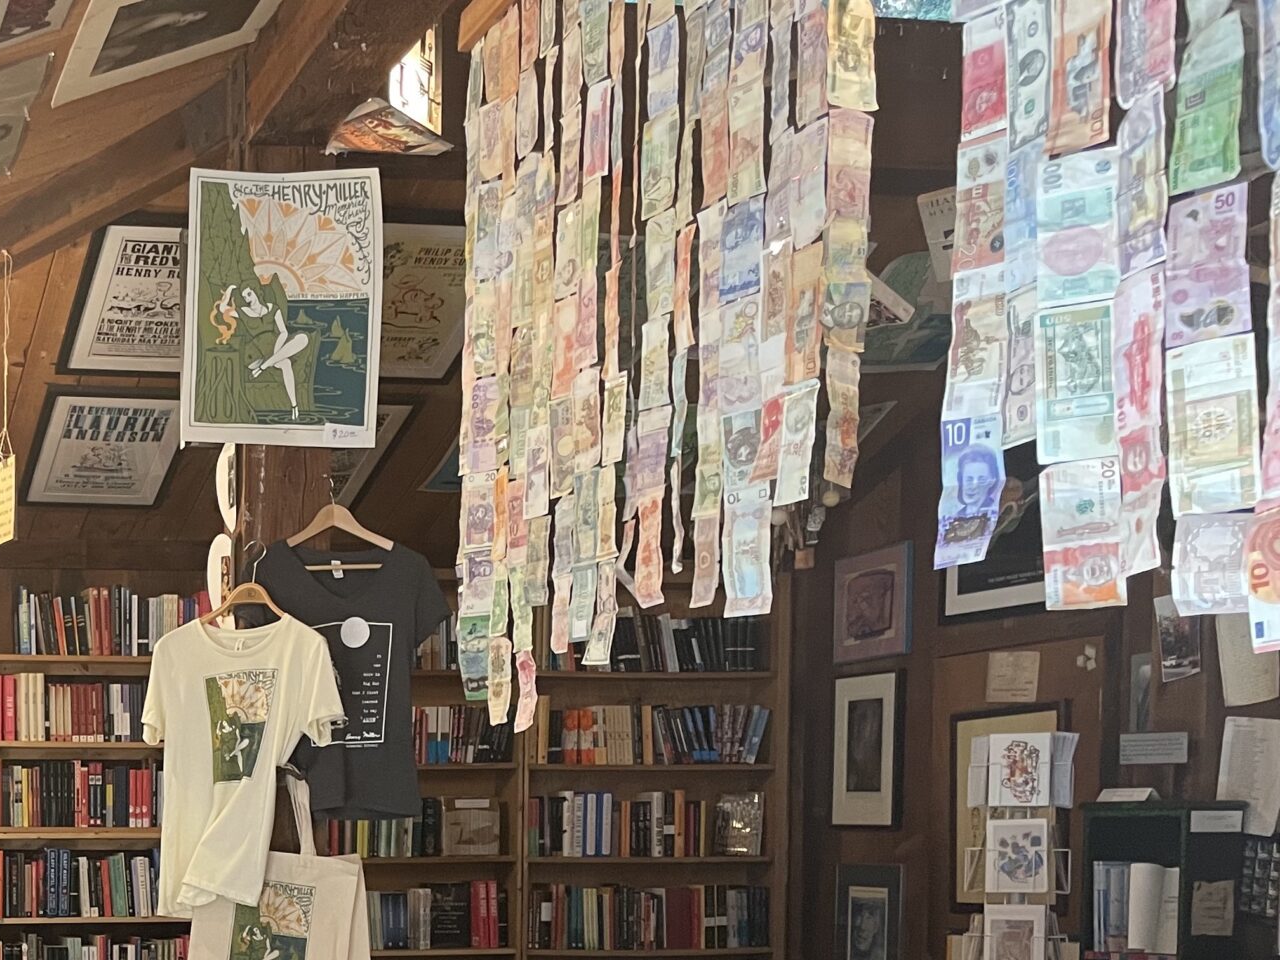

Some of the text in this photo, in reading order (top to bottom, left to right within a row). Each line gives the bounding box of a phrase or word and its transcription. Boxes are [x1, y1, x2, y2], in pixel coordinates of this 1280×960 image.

[1043, 162, 1063, 194] 100
[1214, 191, 1235, 210] 50
[414, 256, 450, 266] WENDY
[115, 266, 161, 278] HENRY
[95, 336, 158, 345] SATURDAY MAY
[70, 405, 156, 418] AN EVENING WITH
[62, 428, 165, 443] ANDERSON
[945, 424, 967, 447] 10
[484, 473, 497, 483] 20
[1100, 460, 1117, 481] 20
[1250, 564, 1271, 595] 10
